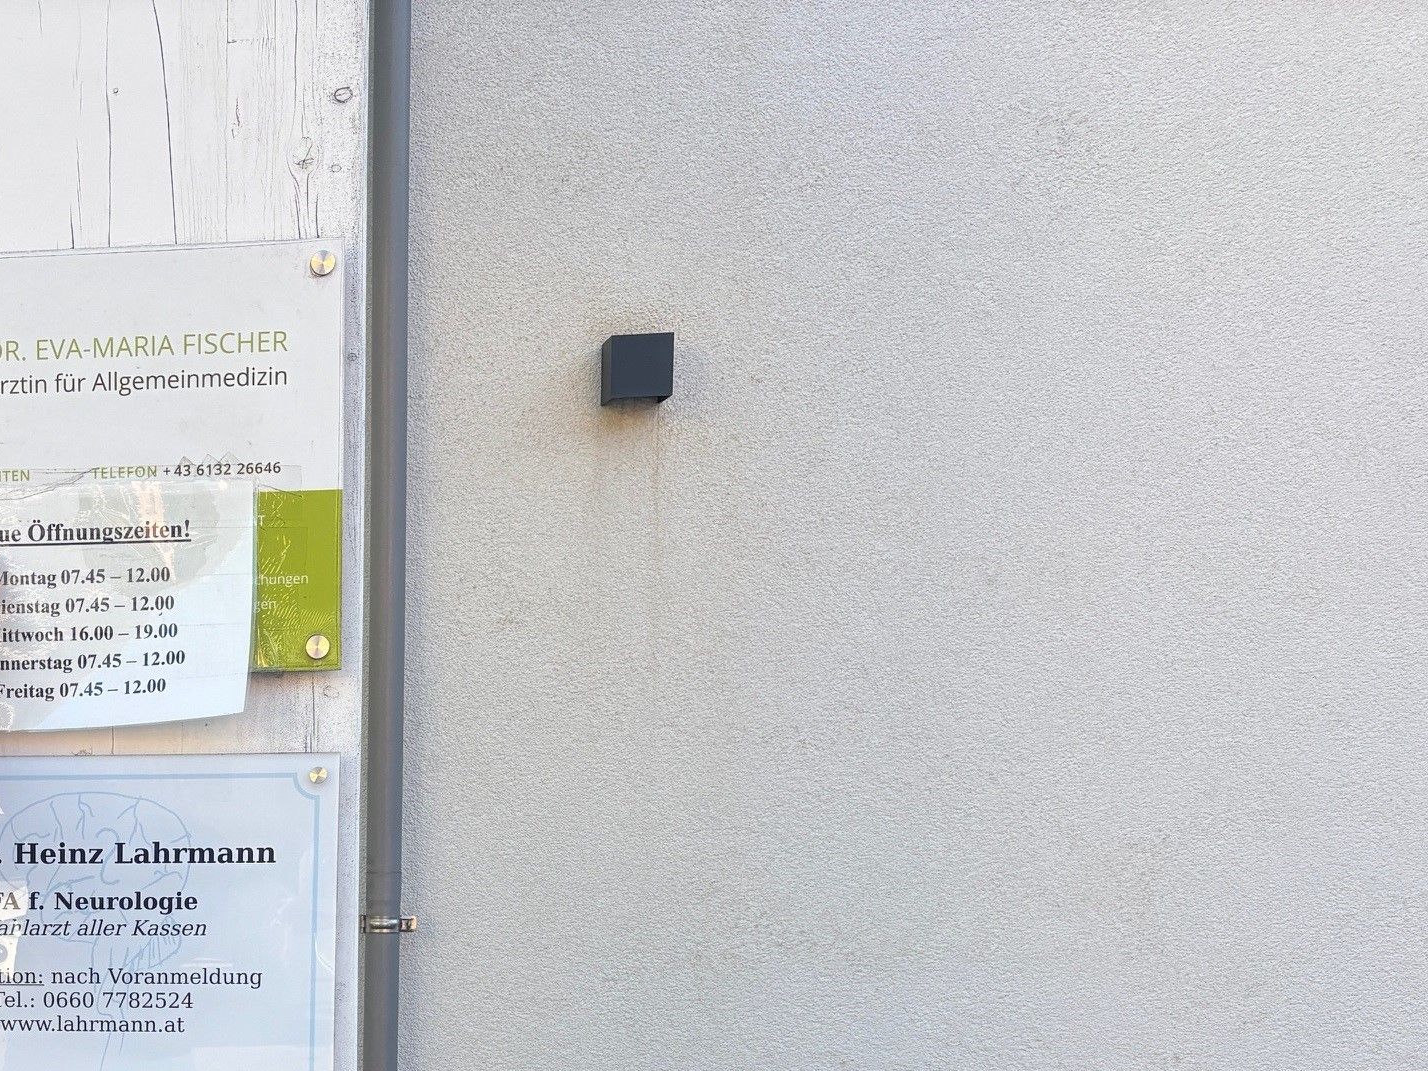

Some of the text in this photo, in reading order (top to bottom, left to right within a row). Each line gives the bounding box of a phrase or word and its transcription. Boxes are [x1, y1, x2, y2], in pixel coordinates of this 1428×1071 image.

[37, 335, 174, 360] EVA-MARIA
[184, 331, 288, 355] FISCHER
[55, 373, 86, 393] für
[92, 367, 288, 396] Allgemeinmedizin
[92, 466, 157, 479] TELEFON
[196, 462, 231, 476] 6132
[236, 461, 282, 475] 26646
[27, 518, 192, 544] Öffnungszeiten!
[61, 569, 105, 584] 07.45
[127, 567, 170, 583] 12.00
[66, 597, 109, 613] 07.45
[131, 596, 174, 611] 12.00
[70, 626, 113, 641] 16.00
[135, 623, 178, 639] 19.00
[78, 654, 121, 669] 07.45
[143, 651, 185, 666] 12.00
[60, 683, 103, 698] 07.45
[124, 679, 166, 694] 12.00
[14, 842, 103, 864] Heinz
[114, 842, 276, 864] Lahrmann
[28, 892, 44, 910] f.
[54, 892, 198, 914] Neurologie
[79, 919, 126, 936] aller
[132, 920, 207, 936] Kassen
[51, 967, 101, 984] nach
[108, 968, 263, 989] Voranmeldung
[43, 992, 94, 1008] 0660
[102, 993, 194, 1009] 7782524
[0, 1016, 185, 1033] www.lahrmann.at
